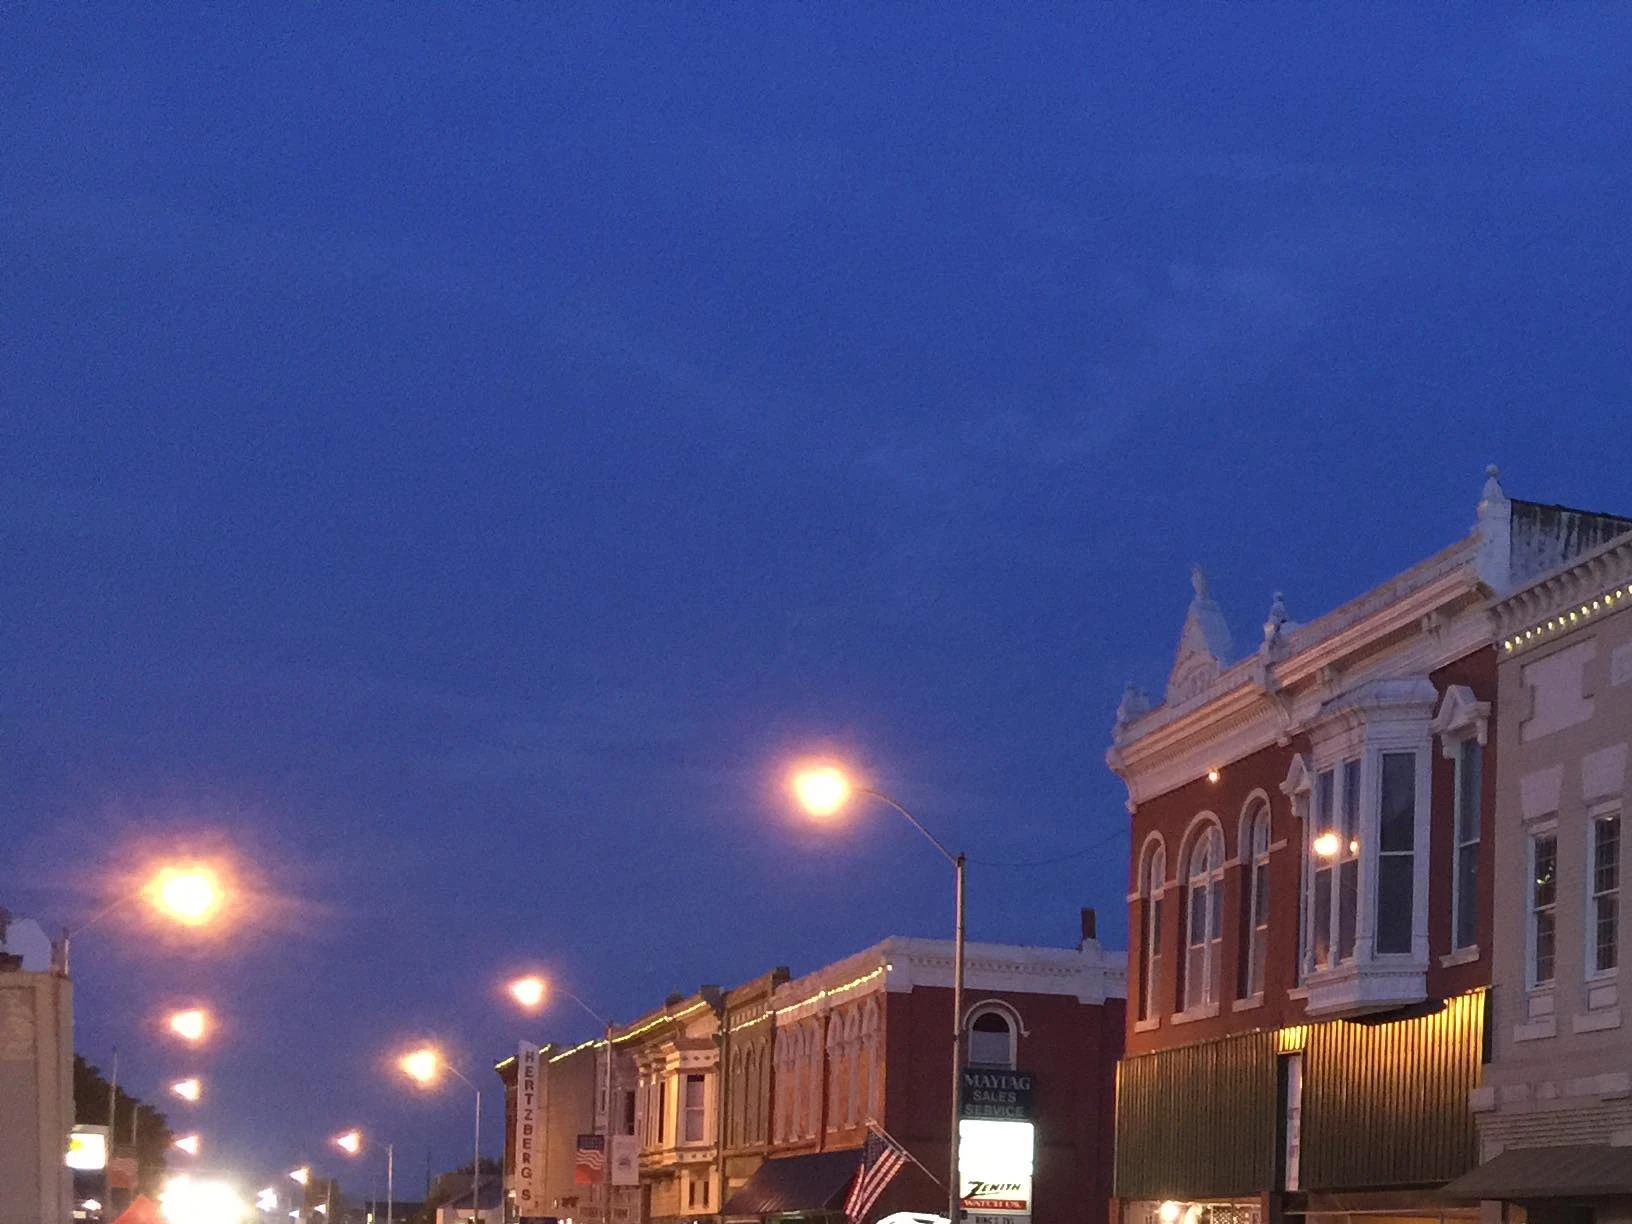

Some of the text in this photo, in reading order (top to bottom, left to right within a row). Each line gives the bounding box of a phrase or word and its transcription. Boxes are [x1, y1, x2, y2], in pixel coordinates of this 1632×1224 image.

[965, 1073, 1031, 1090] MAYTAG
[973, 1089, 1017, 1103] SALES
[965, 1103, 1025, 1117] SERVICE
[960, 1180, 1022, 1199] ZENITH
